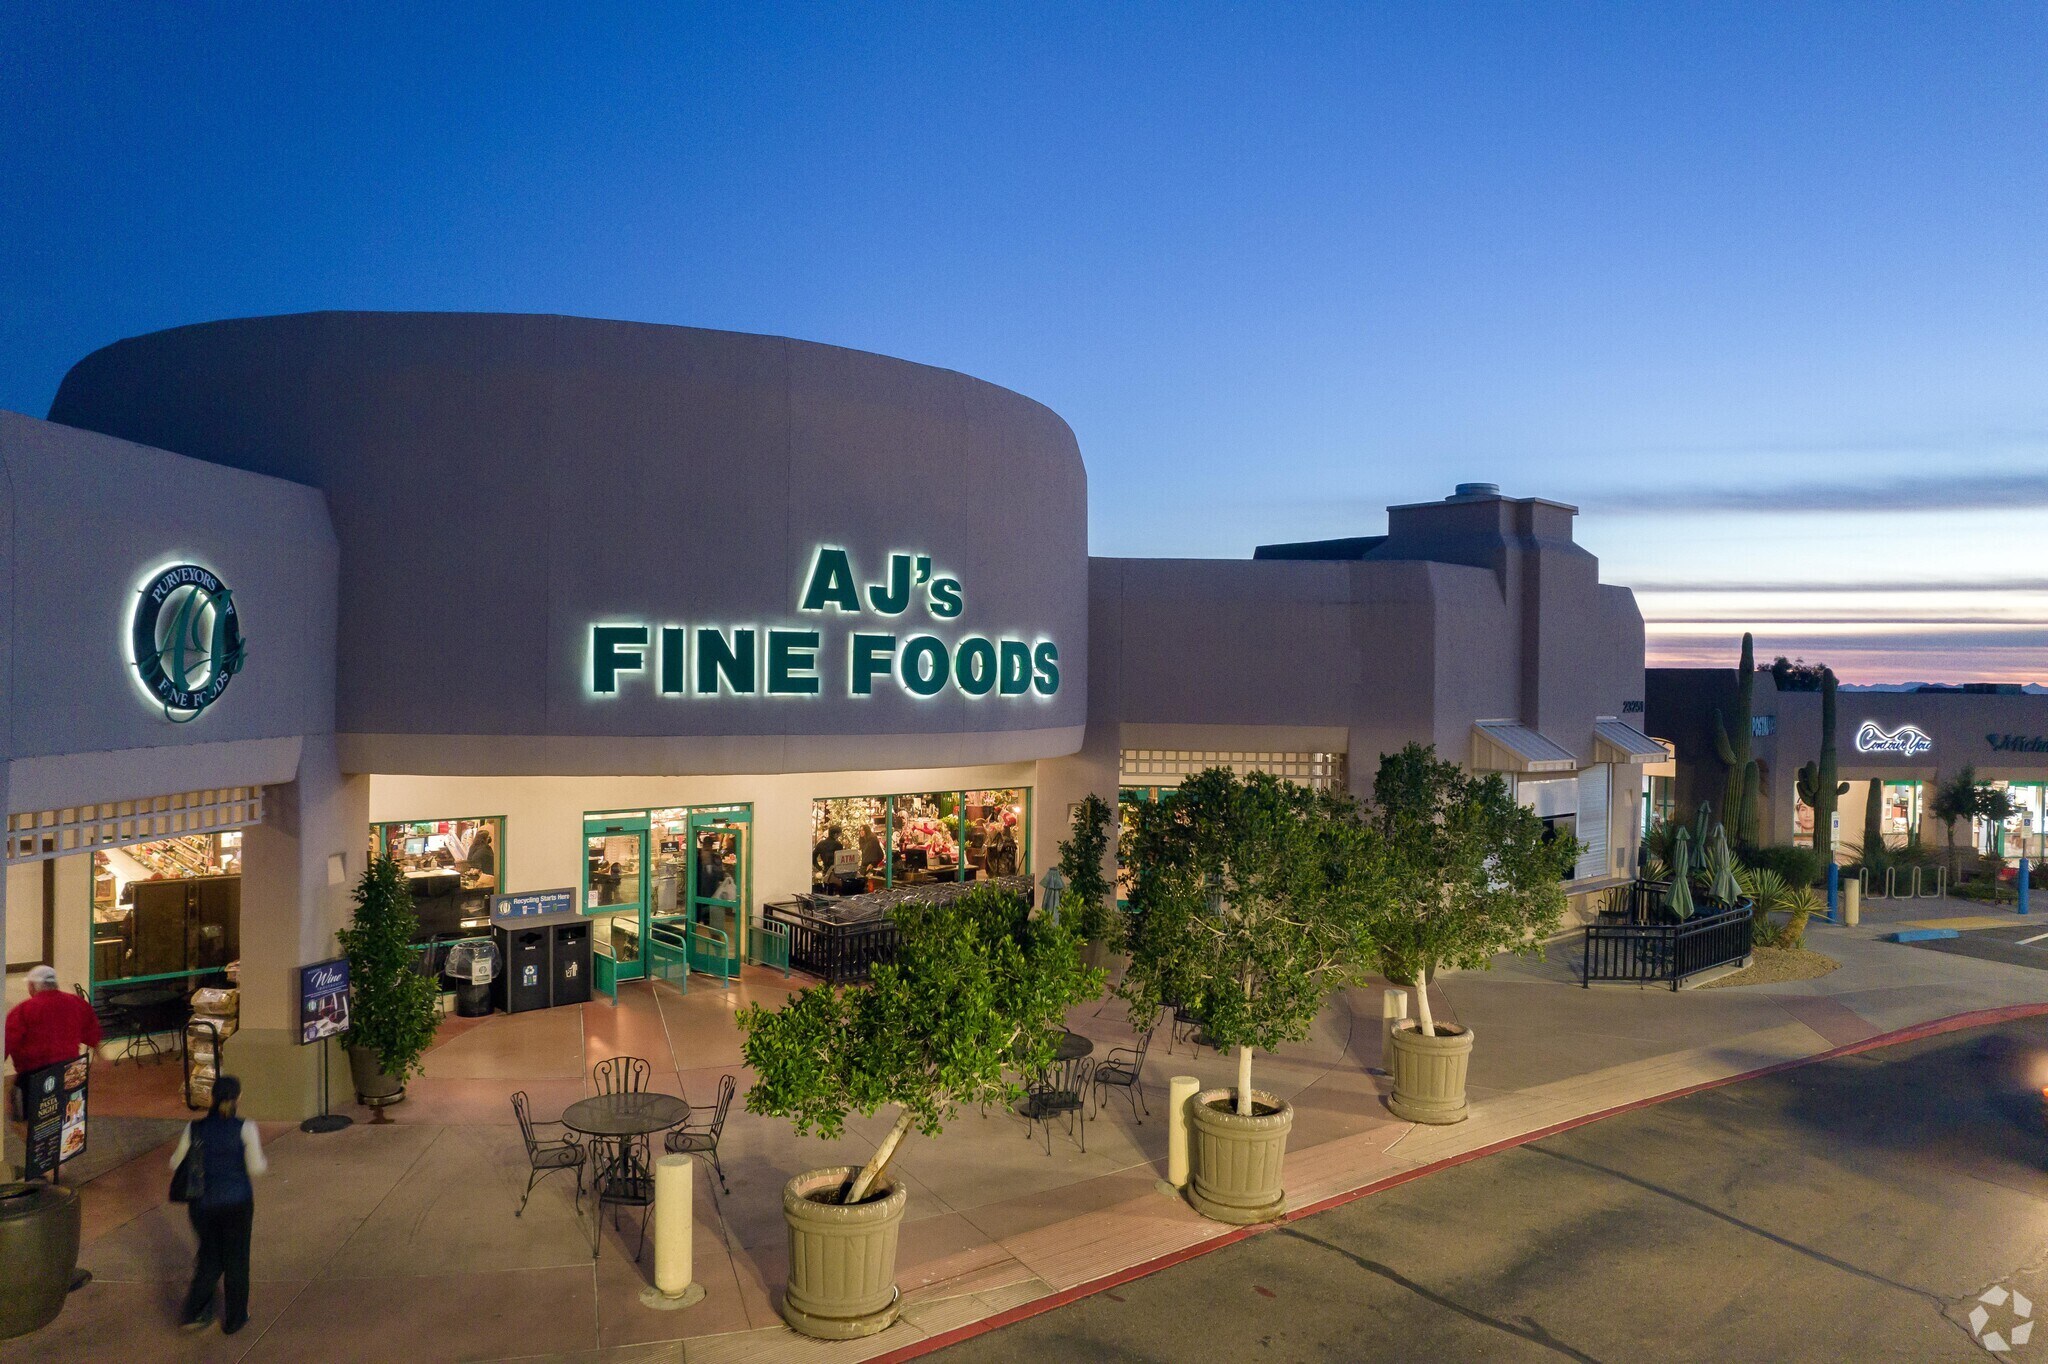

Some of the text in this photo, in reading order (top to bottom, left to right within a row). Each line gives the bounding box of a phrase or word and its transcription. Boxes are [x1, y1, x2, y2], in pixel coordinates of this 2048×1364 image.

[152, 567, 217, 604] PURVEYORS
[801, 547, 964, 618] AJ's
[592, 626, 1061, 696] FINE FOODS
[157, 677, 188, 707] FNE
[1858, 727, 1932, 756] Contour You
[840, 854, 856, 864] ATM
[513, 892, 570, 905] Recycling Starts Here
[310, 967, 342, 988] Wine
[37, 1103, 59, 1118] NIGHT
[39, 1097, 58, 1110] PASTA
